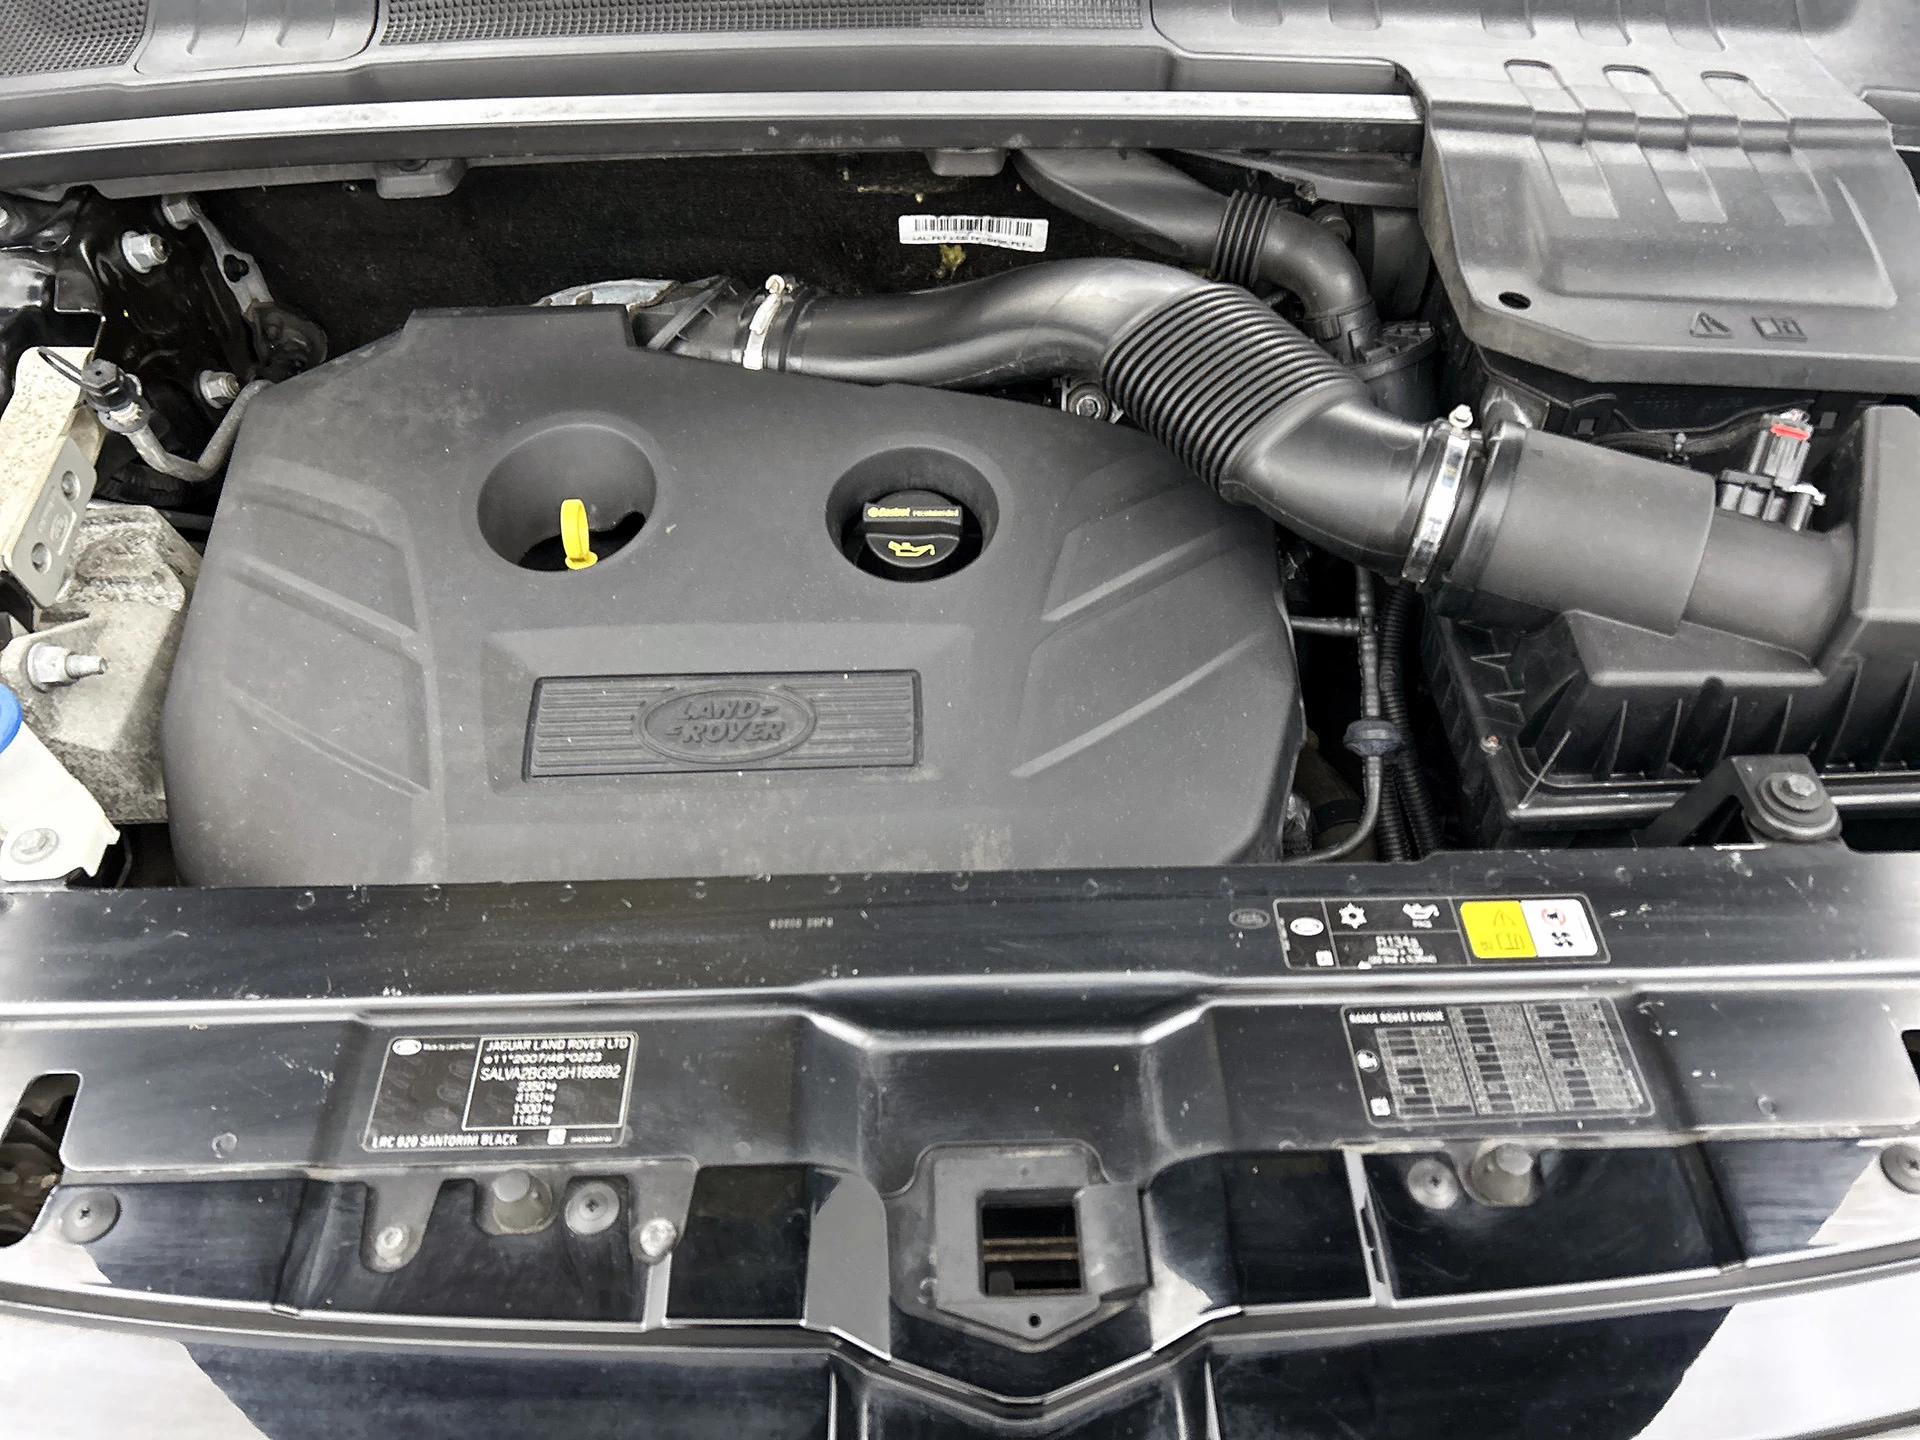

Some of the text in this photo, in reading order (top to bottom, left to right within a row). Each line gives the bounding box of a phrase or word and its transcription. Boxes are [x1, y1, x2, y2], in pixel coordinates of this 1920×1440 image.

[677, 699, 761, 720] LAND
[682, 721, 787, 743] ROVER
[485, 1037, 629, 1052] JAGUAR LAND ROVER LTD
[371, 1134, 396, 1149] LRC
[419, 1132, 479, 1148] SANTORINI
[480, 1132, 518, 1147] BLACK
